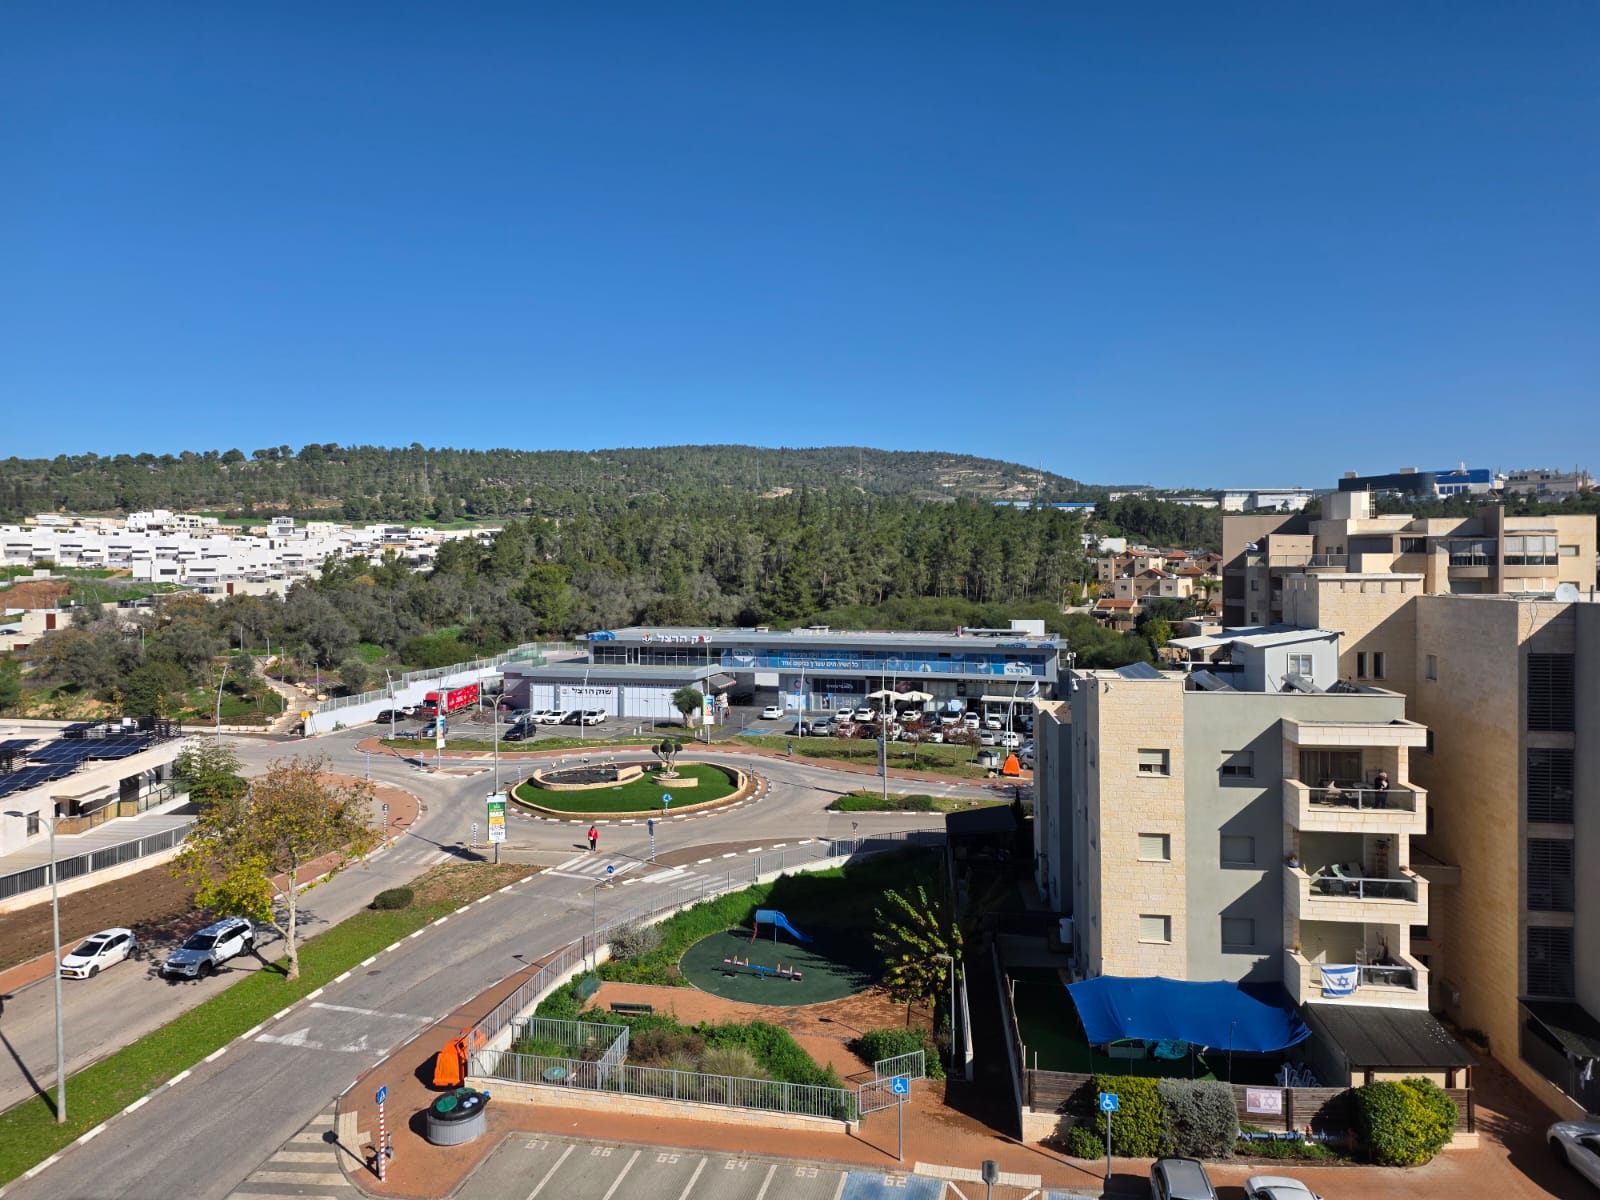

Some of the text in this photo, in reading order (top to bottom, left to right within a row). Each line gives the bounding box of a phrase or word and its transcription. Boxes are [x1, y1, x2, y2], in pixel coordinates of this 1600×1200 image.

[657, 632, 688, 643] הרצל
[571, 687, 612, 696] שוק הרצל
[524, 1139, 549, 1150] 67
[590, 1145, 614, 1158] 66
[655, 1152, 681, 1165] 65
[724, 1159, 749, 1171] 64
[794, 1166, 819, 1179] 63
[883, 1175, 908, 1188] 62
